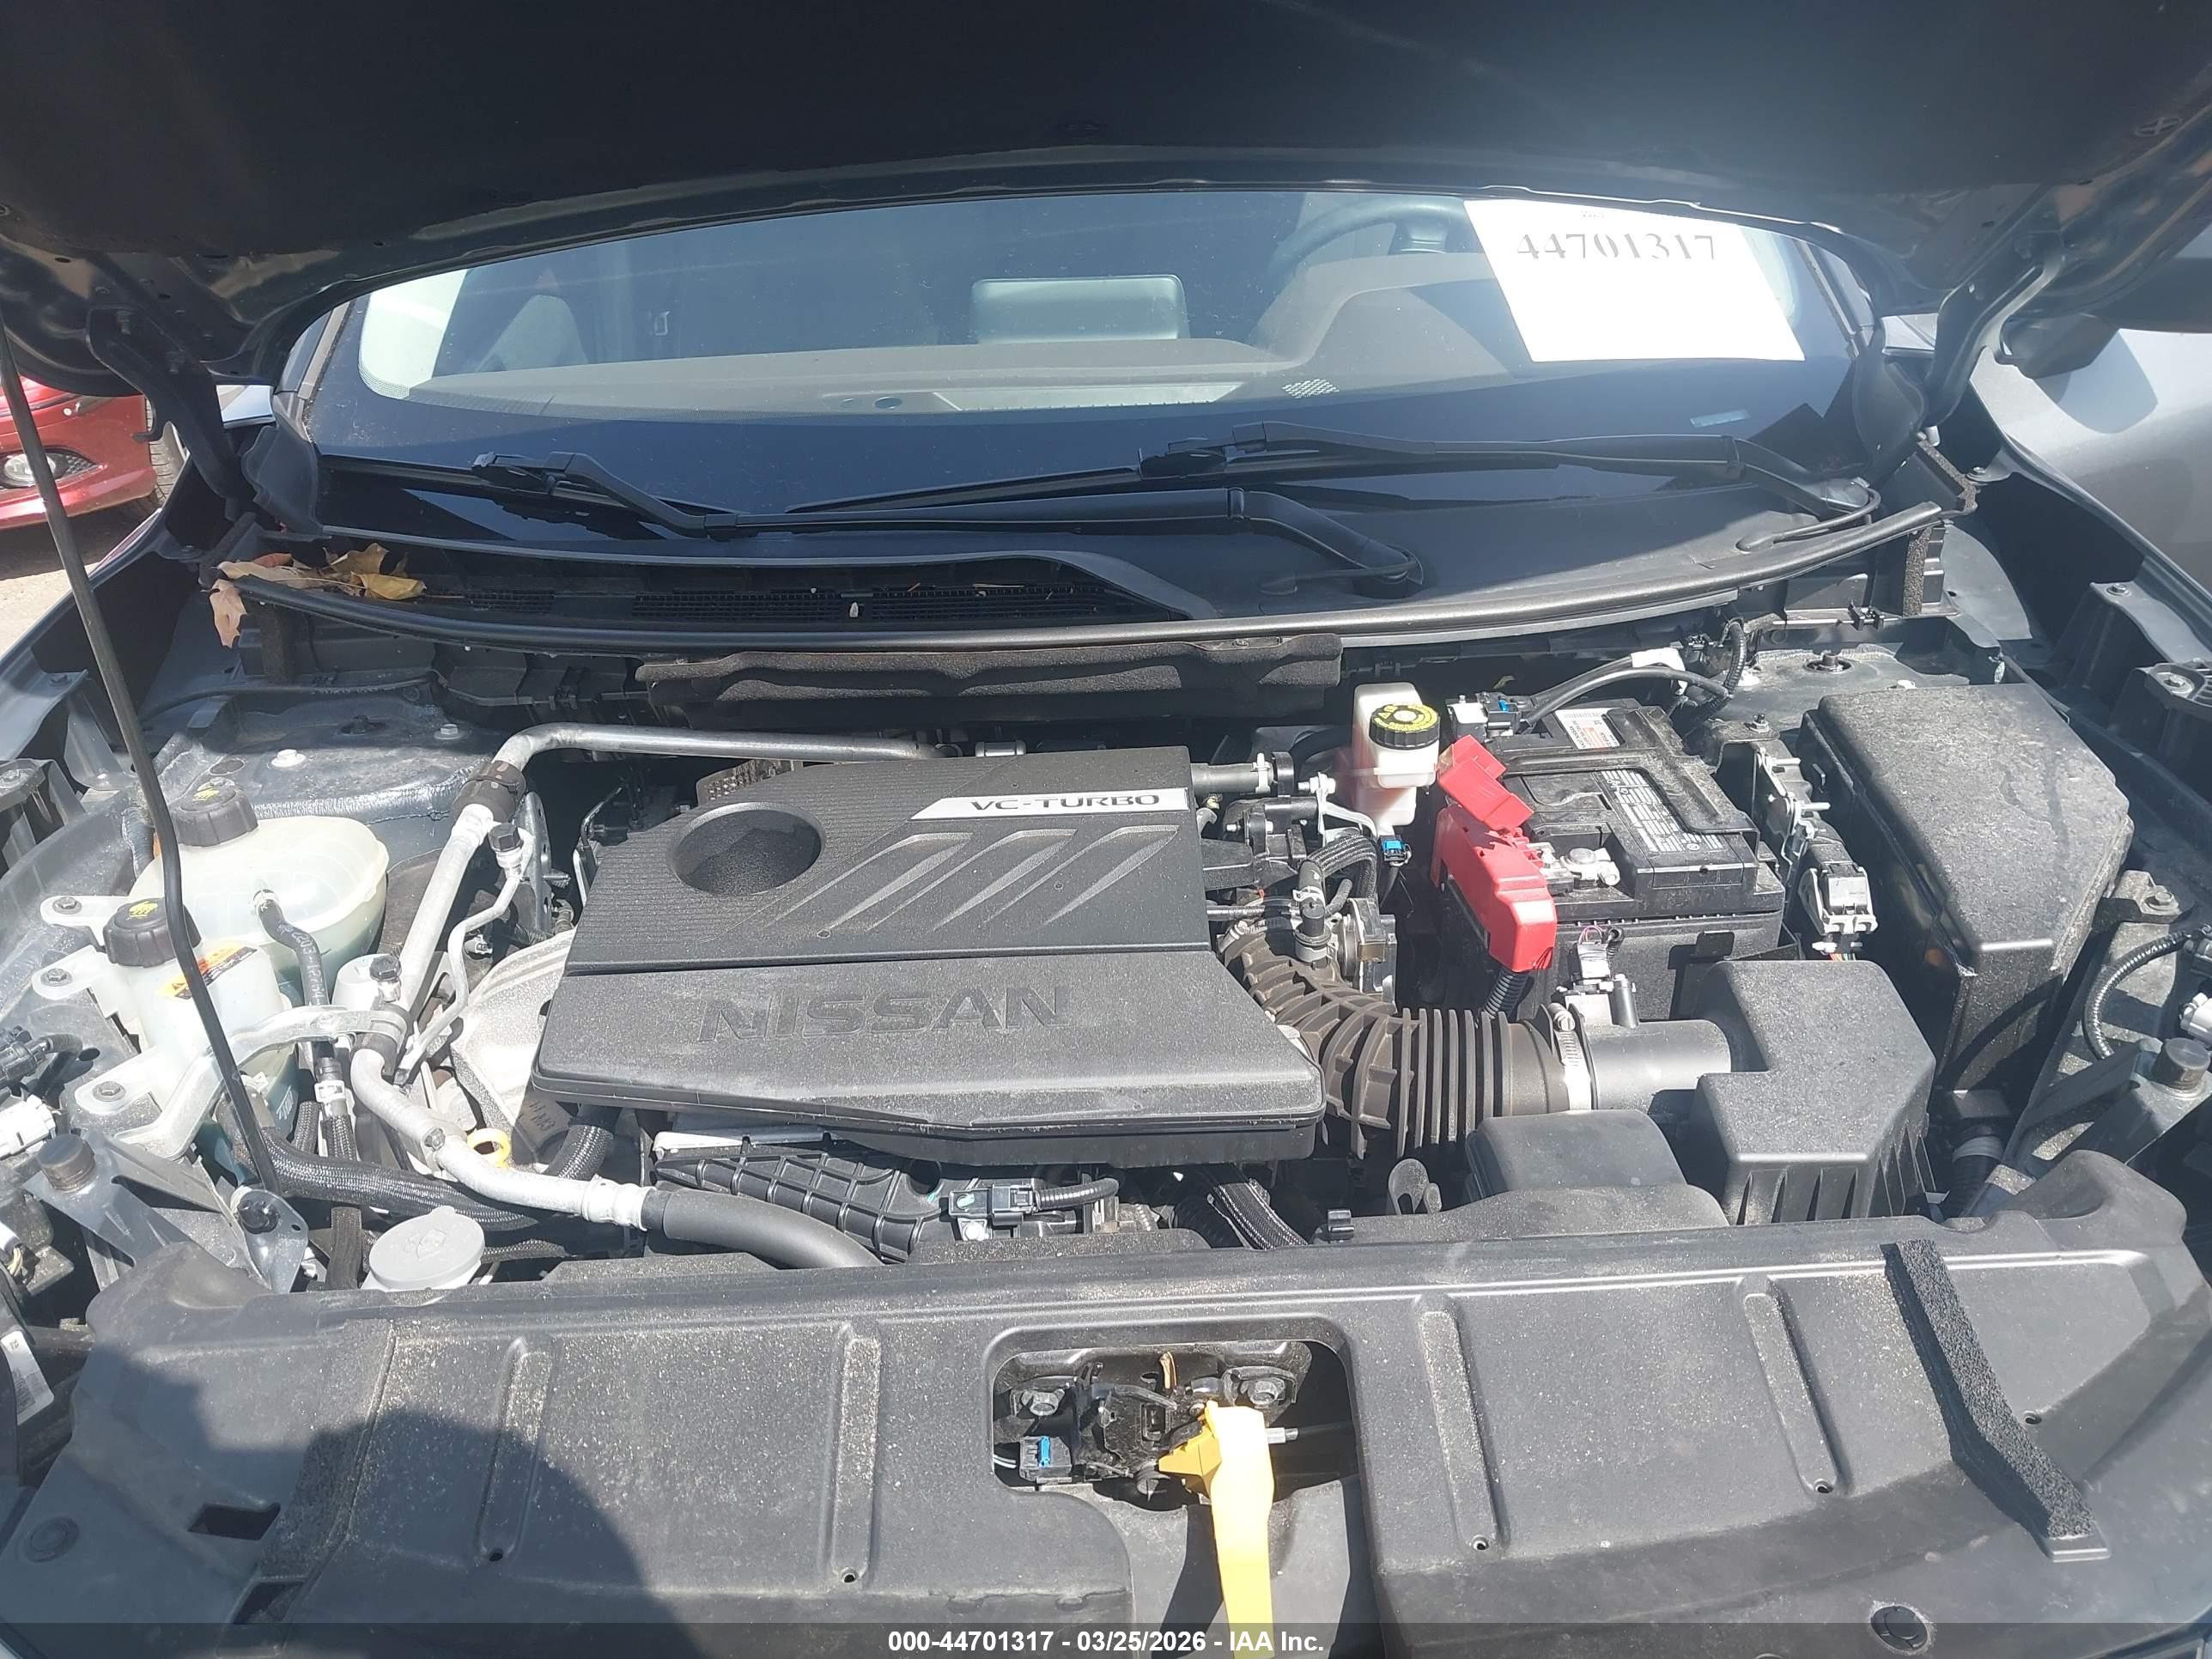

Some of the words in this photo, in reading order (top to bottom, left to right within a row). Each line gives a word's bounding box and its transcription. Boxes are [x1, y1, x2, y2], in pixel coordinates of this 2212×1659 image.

[1517, 234, 1714, 260] 44701317
[970, 794, 1159, 811] VC-TURBO
[698, 987, 1072, 1042] NISSAN
